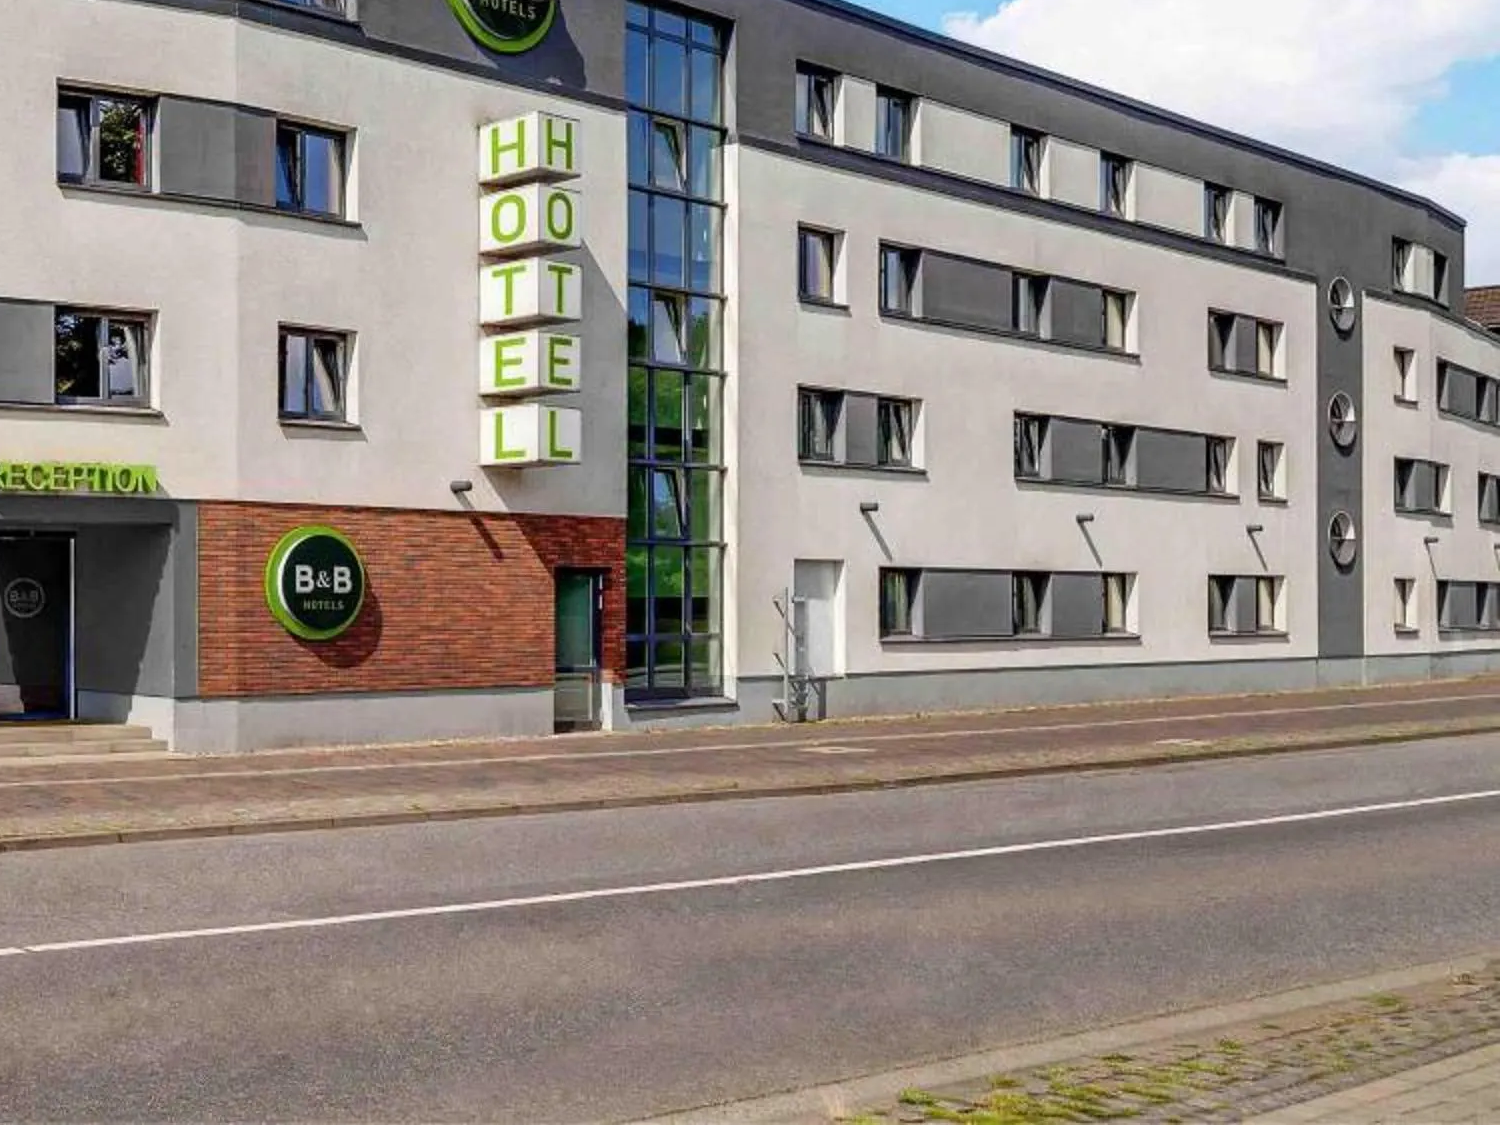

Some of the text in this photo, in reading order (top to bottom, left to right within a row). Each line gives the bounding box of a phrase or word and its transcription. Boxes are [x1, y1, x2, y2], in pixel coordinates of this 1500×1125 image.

[491, 119, 526, 460] HOTEL
[546, 118, 573, 459] HOTEL
[295, 564, 353, 594] B&B
[303, 598, 345, 611] HOTELS
